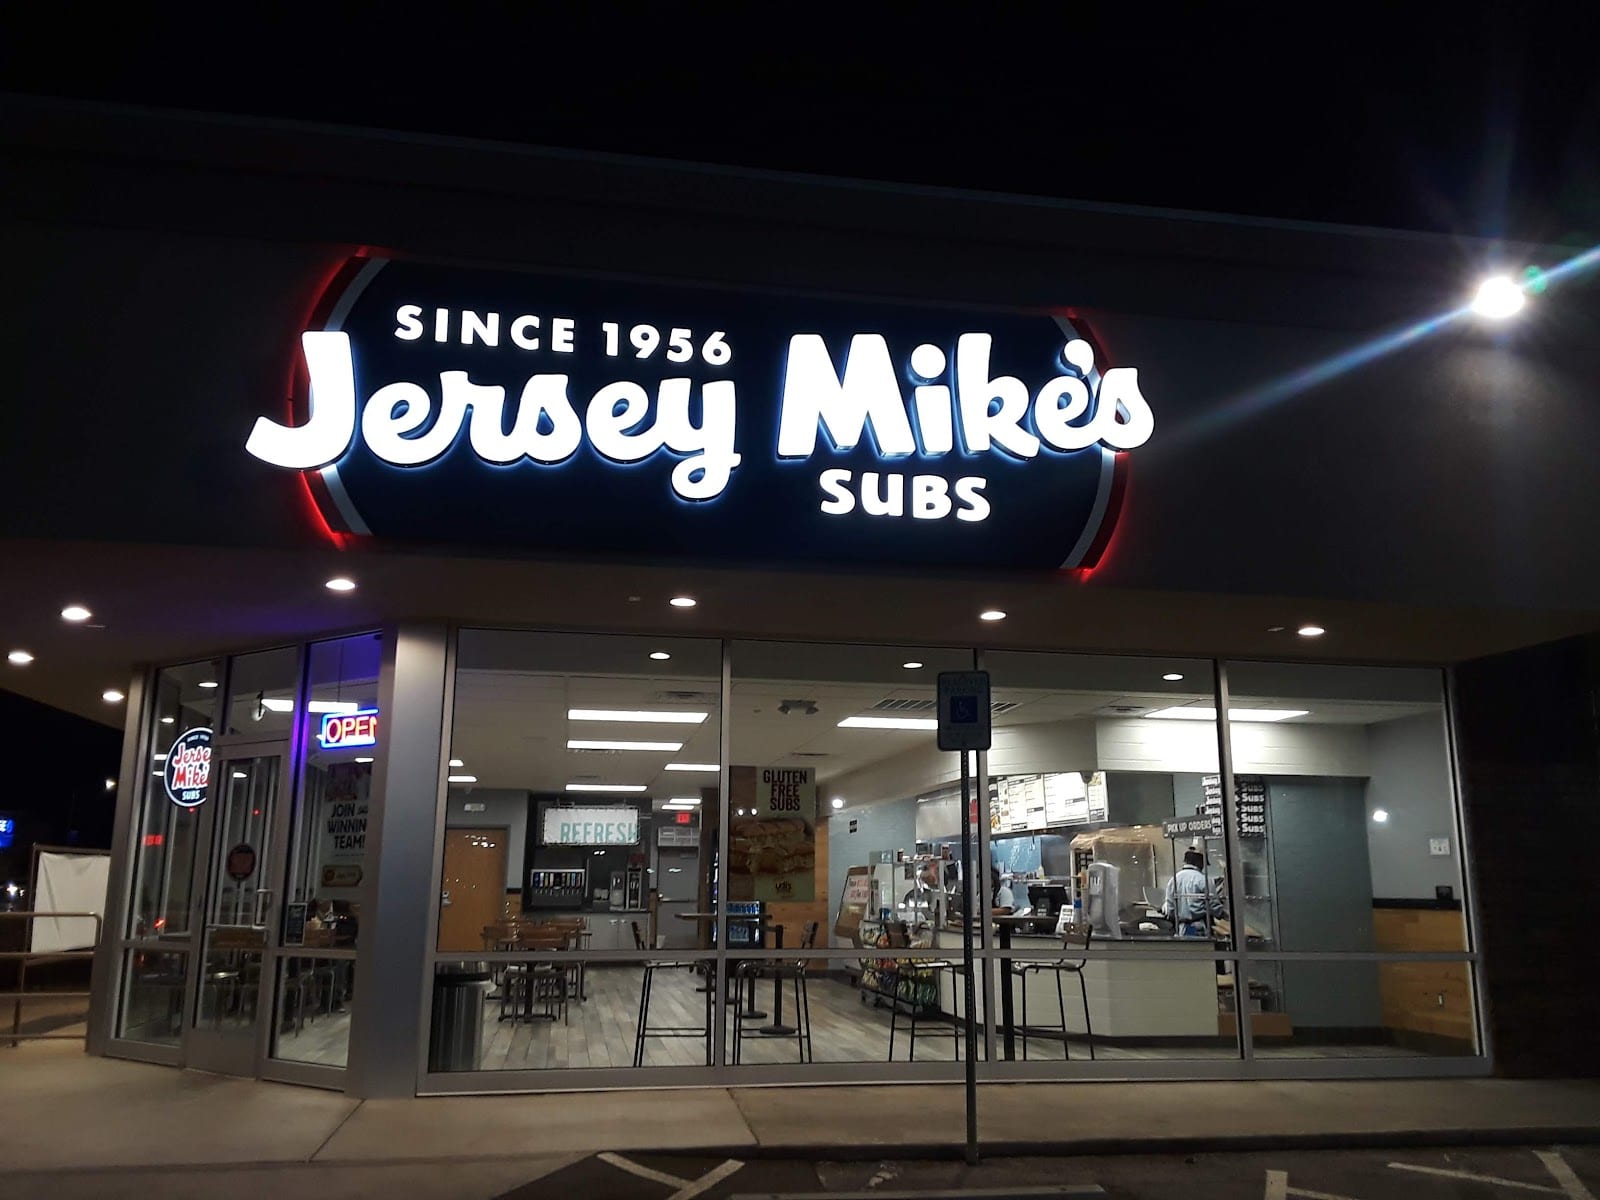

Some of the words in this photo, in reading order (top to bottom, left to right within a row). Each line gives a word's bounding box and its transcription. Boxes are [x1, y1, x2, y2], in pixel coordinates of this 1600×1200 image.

[394, 303, 576, 354] SINCE
[601, 321, 732, 367] 1956
[245, 330, 742, 502] Jersey
[777, 332, 1155, 460] Mike's
[818, 468, 990, 523] SUBS
[763, 770, 807, 784] GLUTEN
[771, 784, 800, 798] FREE
[331, 803, 356, 818] JOIN
[770, 797, 801, 811] SUBS
[334, 834, 366, 849] TEAM!
